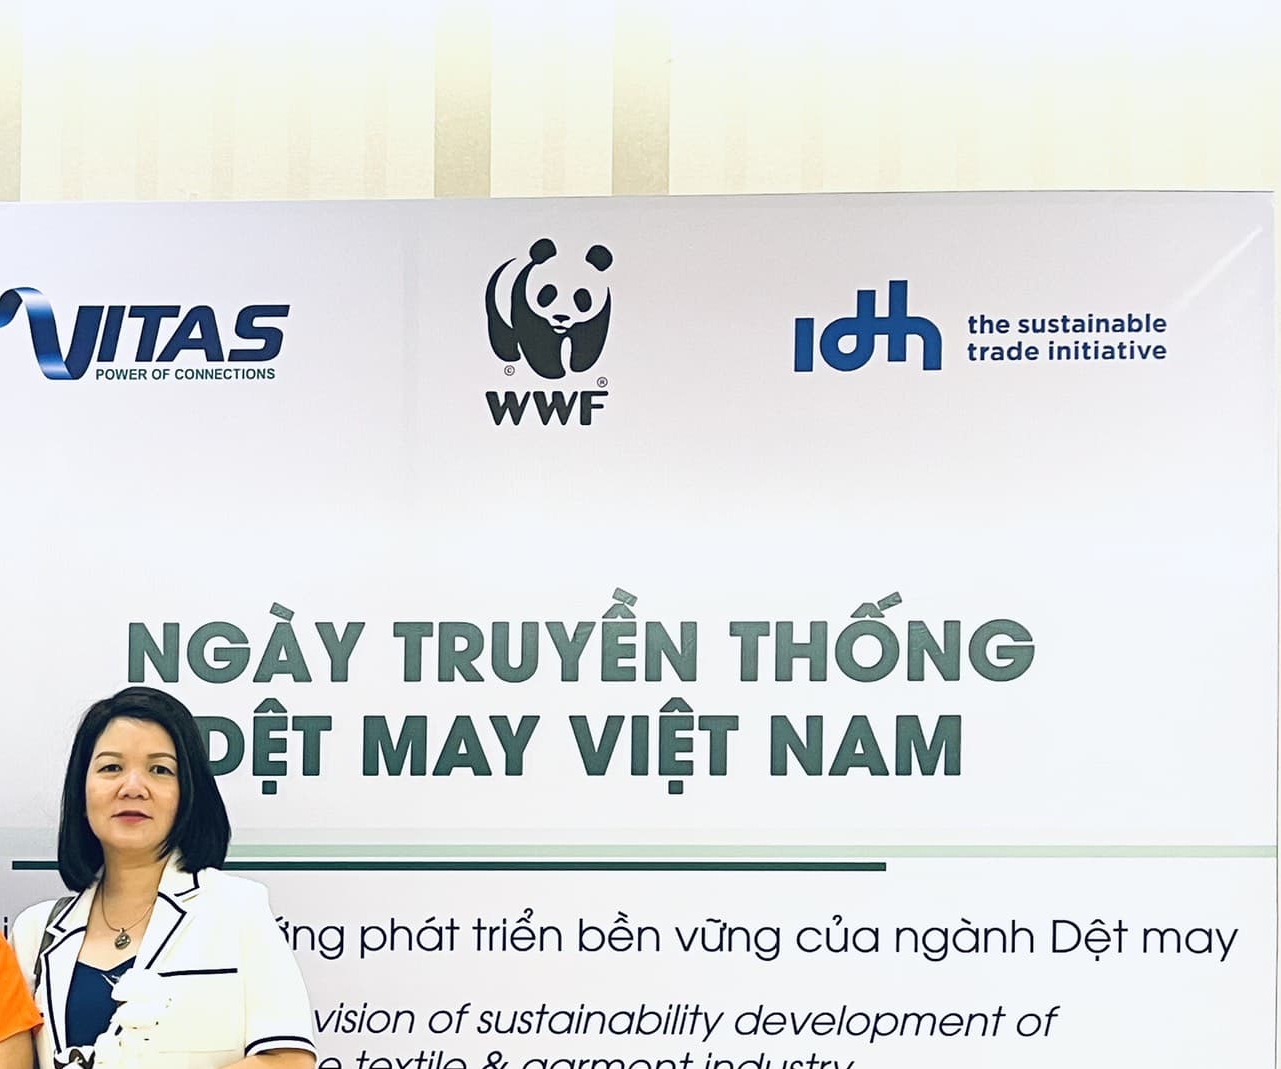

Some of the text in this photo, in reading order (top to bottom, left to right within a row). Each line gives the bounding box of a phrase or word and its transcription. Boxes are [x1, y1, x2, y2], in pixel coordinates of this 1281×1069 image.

[967, 313, 1167, 335] the sustainable
[967, 340, 1167, 362] trade initiative
[95, 367, 276, 381] POWER OF CONNECTIONS
[485, 390, 609, 426] WWF
[126, 587, 1036, 684] NGÀY TRUYỀN THỐNG
[192, 696, 962, 796] DỆT MAY VIỆT NAM
[360, 916, 460, 959] phát
[471, 907, 562, 952] triển
[578, 910, 660, 952] bền
[674, 918, 781, 962] vững
[796, 914, 879, 953] của
[895, 917, 1034, 962] ngành
[1052, 918, 1129, 962] Dệt
[1143, 927, 1239, 963] may
[314, 1002, 1061, 1044] vision of sustainability development of
